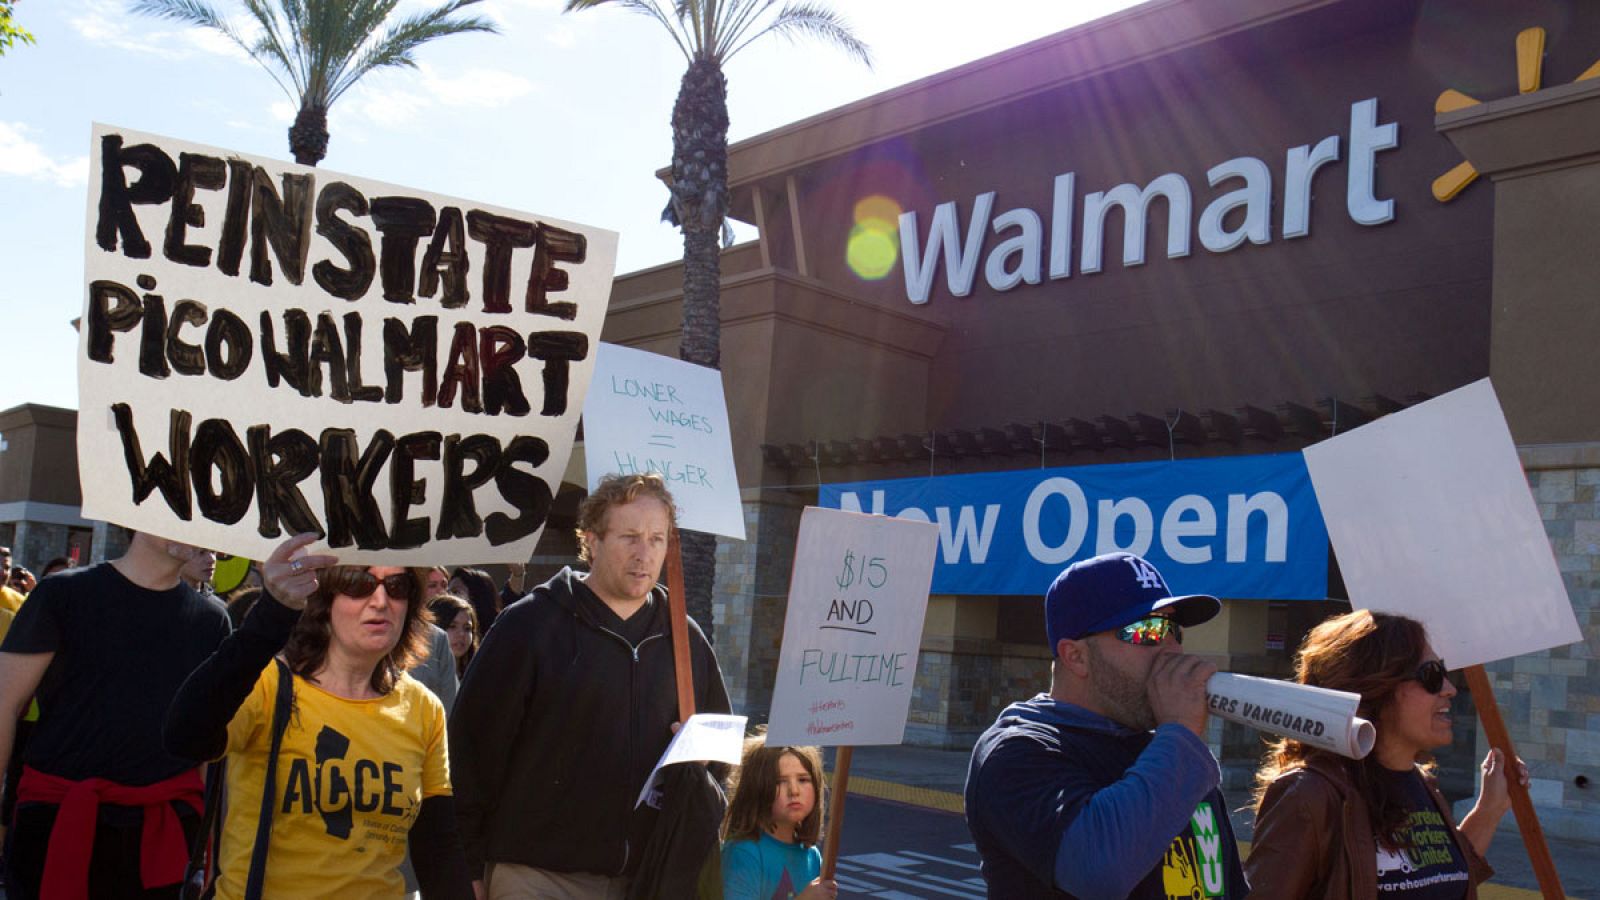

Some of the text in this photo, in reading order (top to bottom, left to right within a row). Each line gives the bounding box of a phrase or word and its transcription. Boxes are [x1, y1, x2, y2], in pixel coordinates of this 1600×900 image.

[899, 97, 1399, 305] Walmart
[96, 133, 587, 320] REINSTATE
[260, 308, 588, 416] WALMART
[611, 375, 684, 405] LOWER
[648, 407, 713, 434] WAGES
[111, 402, 552, 550] WORKERS
[614, 450, 714, 489] HUNGER
[1022, 476, 1289, 565] Open
[835, 548, 888, 592] $15
[1122, 556, 1162, 589] LA
[826, 599, 874, 625] AND
[799, 648, 908, 687] FULLTIME
[1242, 701, 1326, 738] VANGUARD
[281, 757, 404, 817] ACCE
[1192, 805, 1223, 893] WWU
